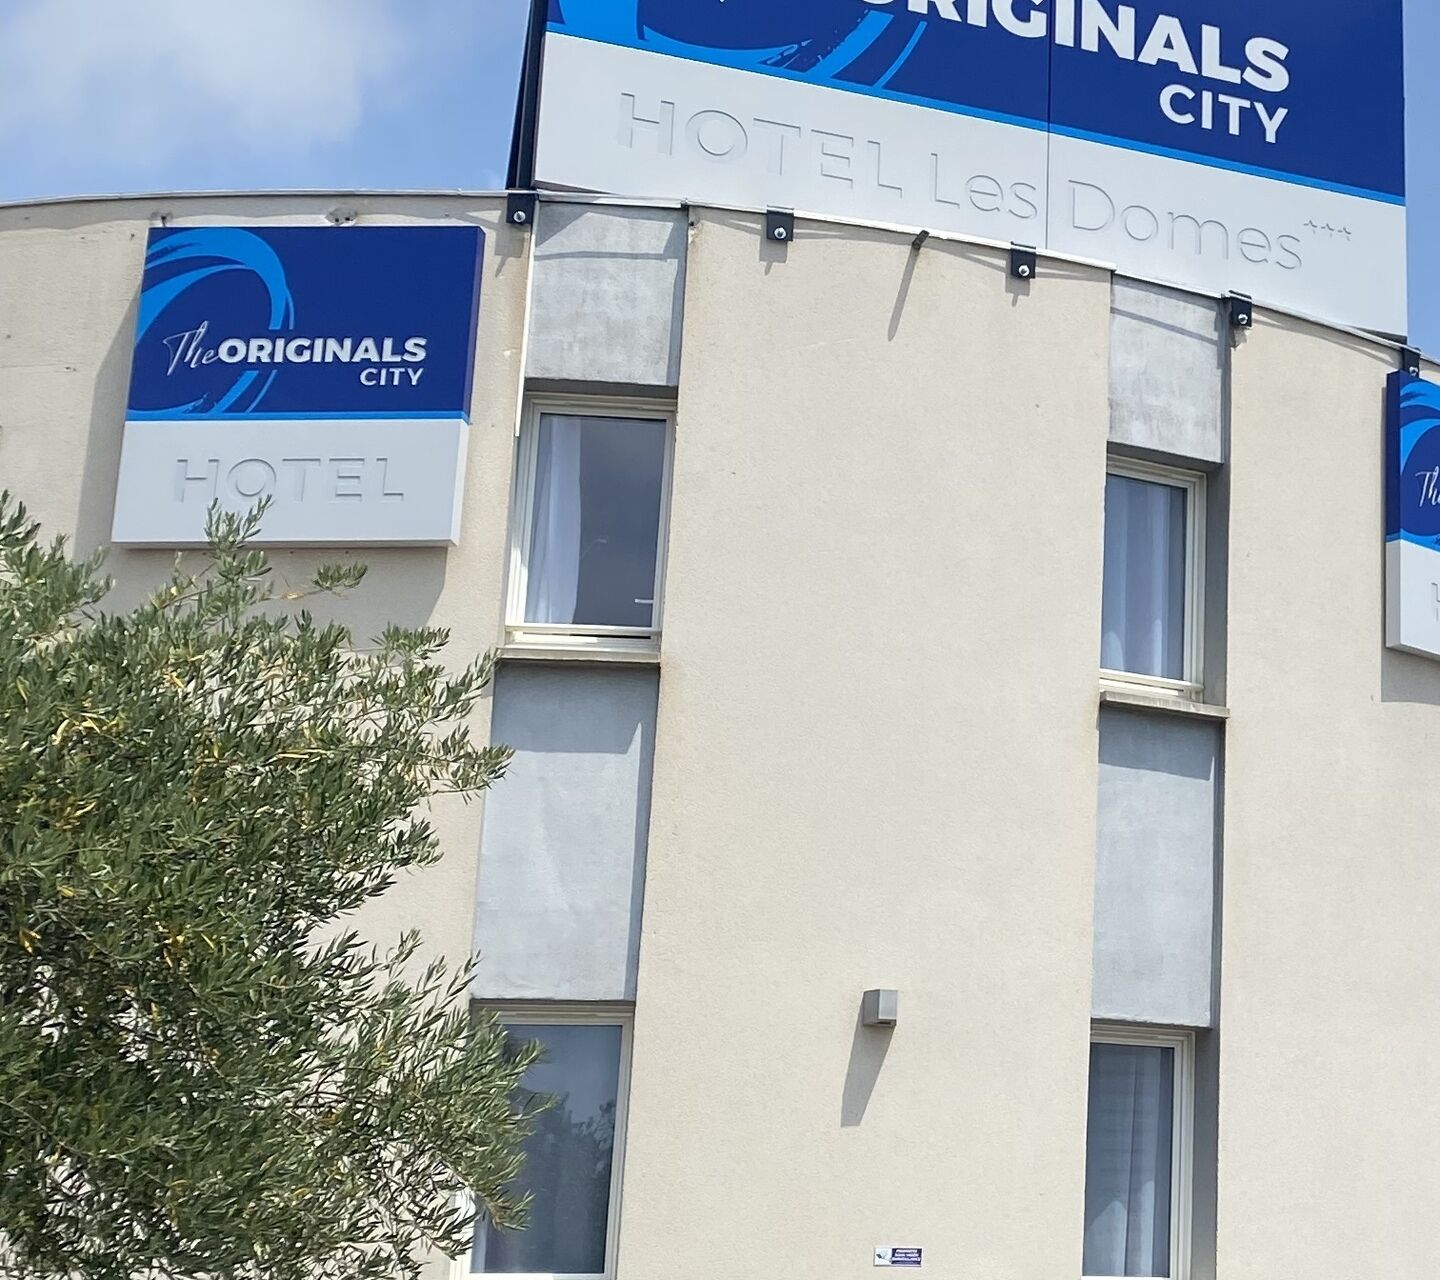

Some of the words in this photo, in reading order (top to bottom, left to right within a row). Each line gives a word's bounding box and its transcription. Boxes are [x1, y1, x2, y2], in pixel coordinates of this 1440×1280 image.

[1159, 83, 1289, 144] CITY
[619, 91, 905, 200] HOTEL
[930, 151, 1038, 222] Les
[217, 337, 428, 363] ORIGINALS
[359, 367, 424, 386] CITY
[176, 457, 405, 503] HOTEL
